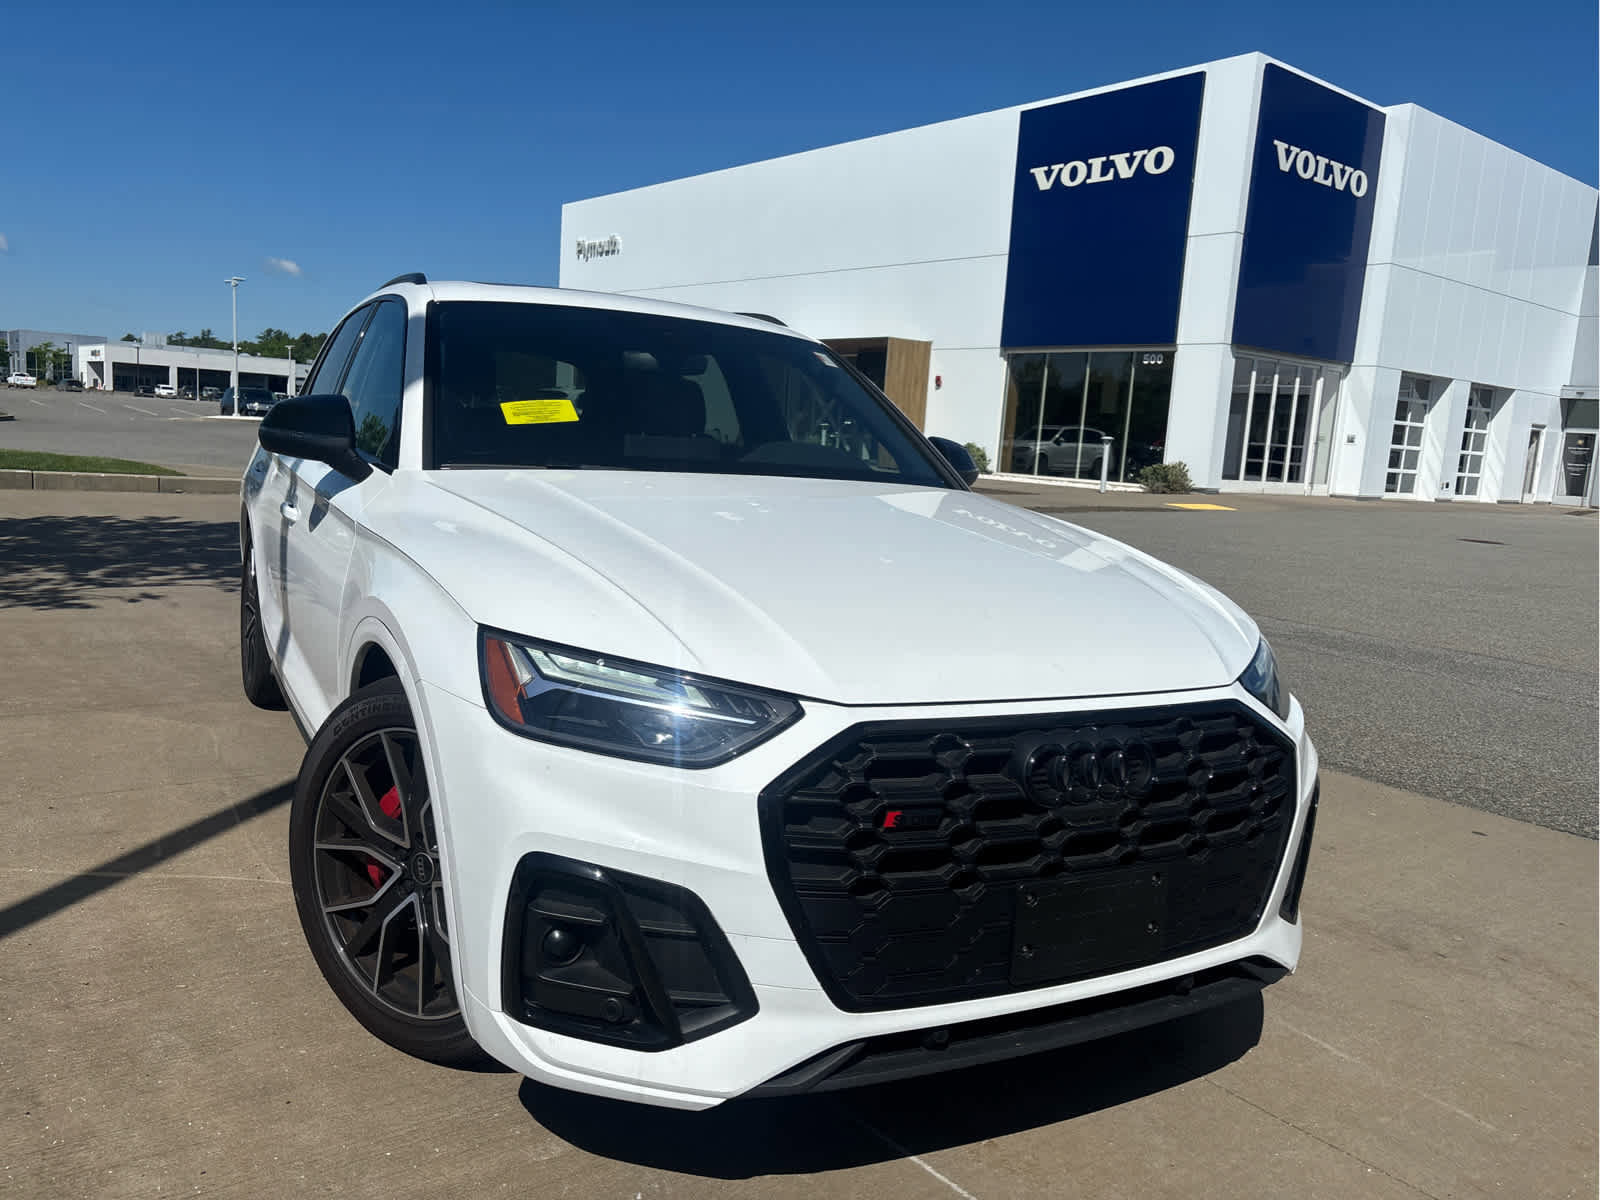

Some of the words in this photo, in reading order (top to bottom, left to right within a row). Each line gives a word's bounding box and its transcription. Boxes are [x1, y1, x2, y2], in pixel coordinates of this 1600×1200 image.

[1030, 145, 1176, 191] VOLVO
[1273, 139, 1368, 198] VOLVO
[576, 234, 622, 263] Plymouth
[1143, 353, 1164, 365] 500
